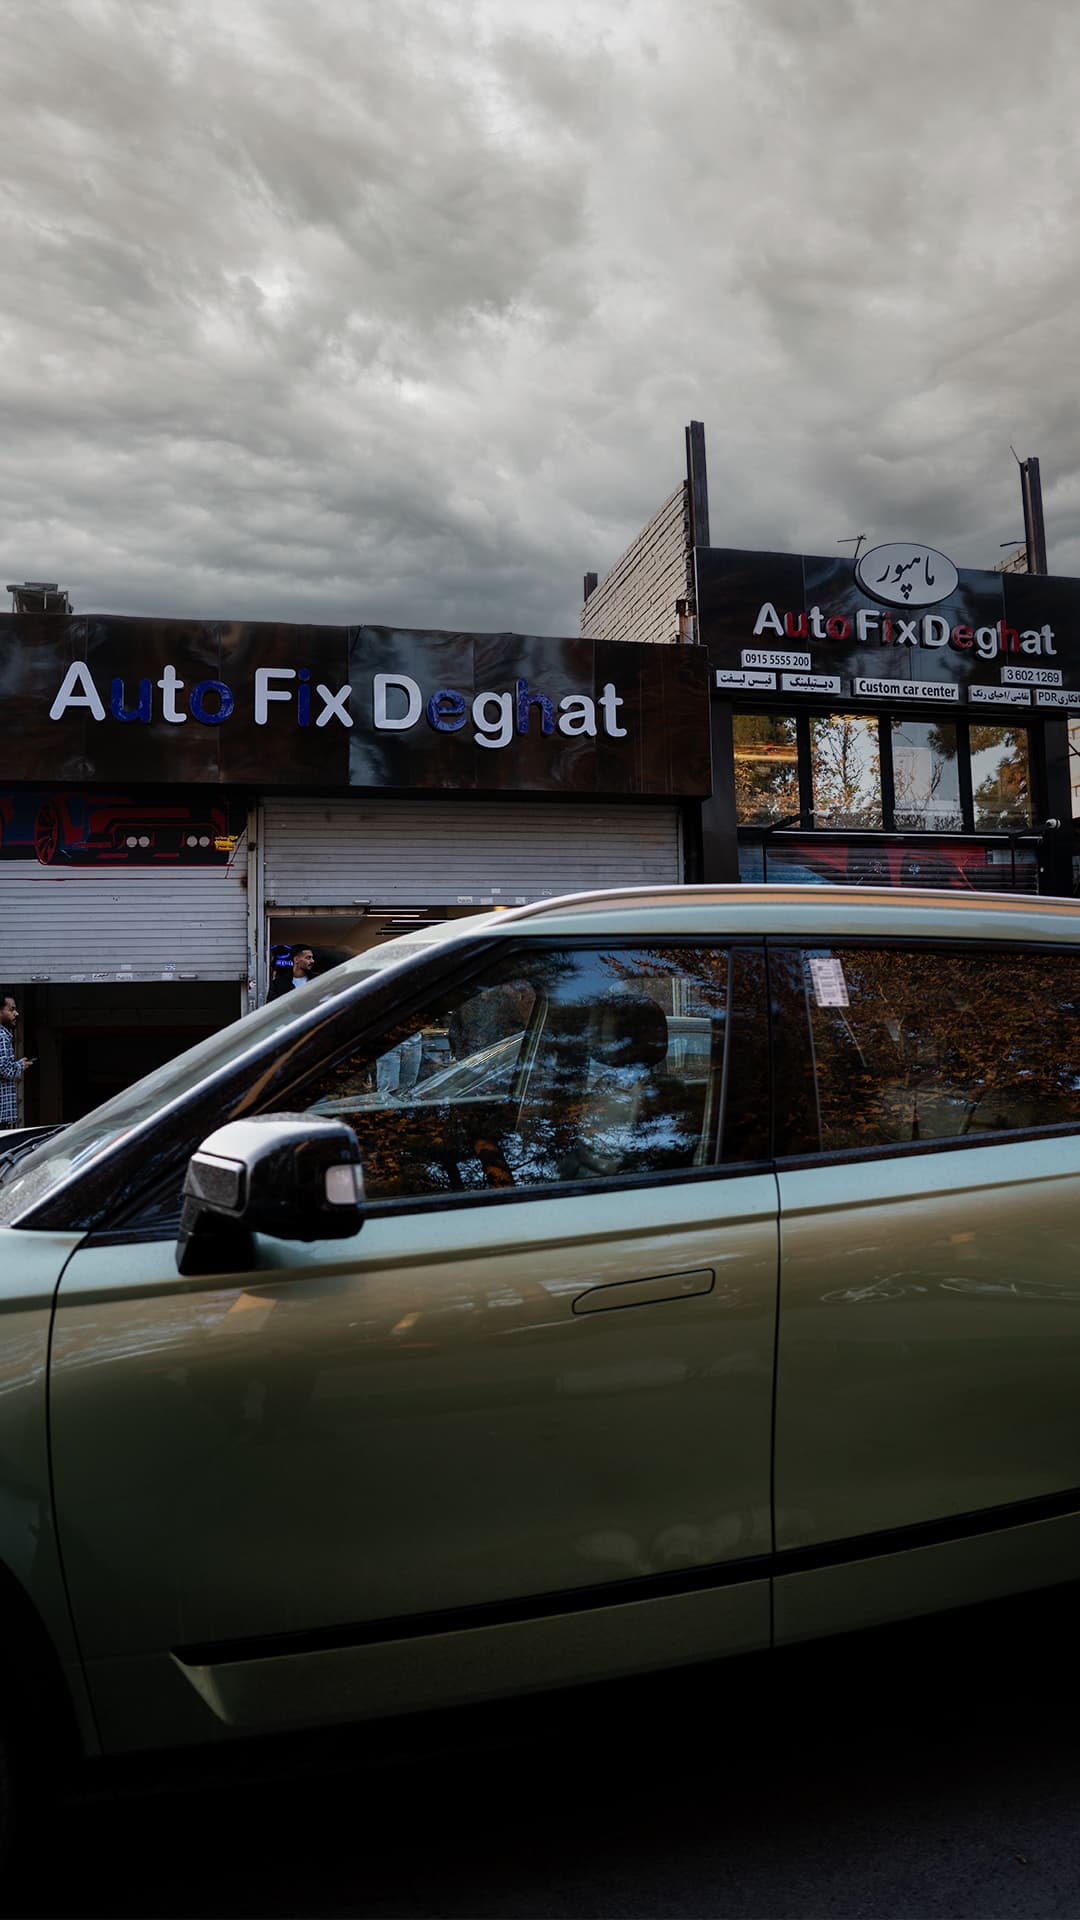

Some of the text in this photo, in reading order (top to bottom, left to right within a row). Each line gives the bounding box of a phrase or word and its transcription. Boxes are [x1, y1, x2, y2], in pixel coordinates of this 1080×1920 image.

[752, 602, 851, 641] Auto
[745, 653, 810, 667] 0915 5555 200
[859, 680, 956, 698] Custom car center
[1038, 691, 1058, 702] PDR
[49, 660, 627, 749] Auto Fix Deghat
